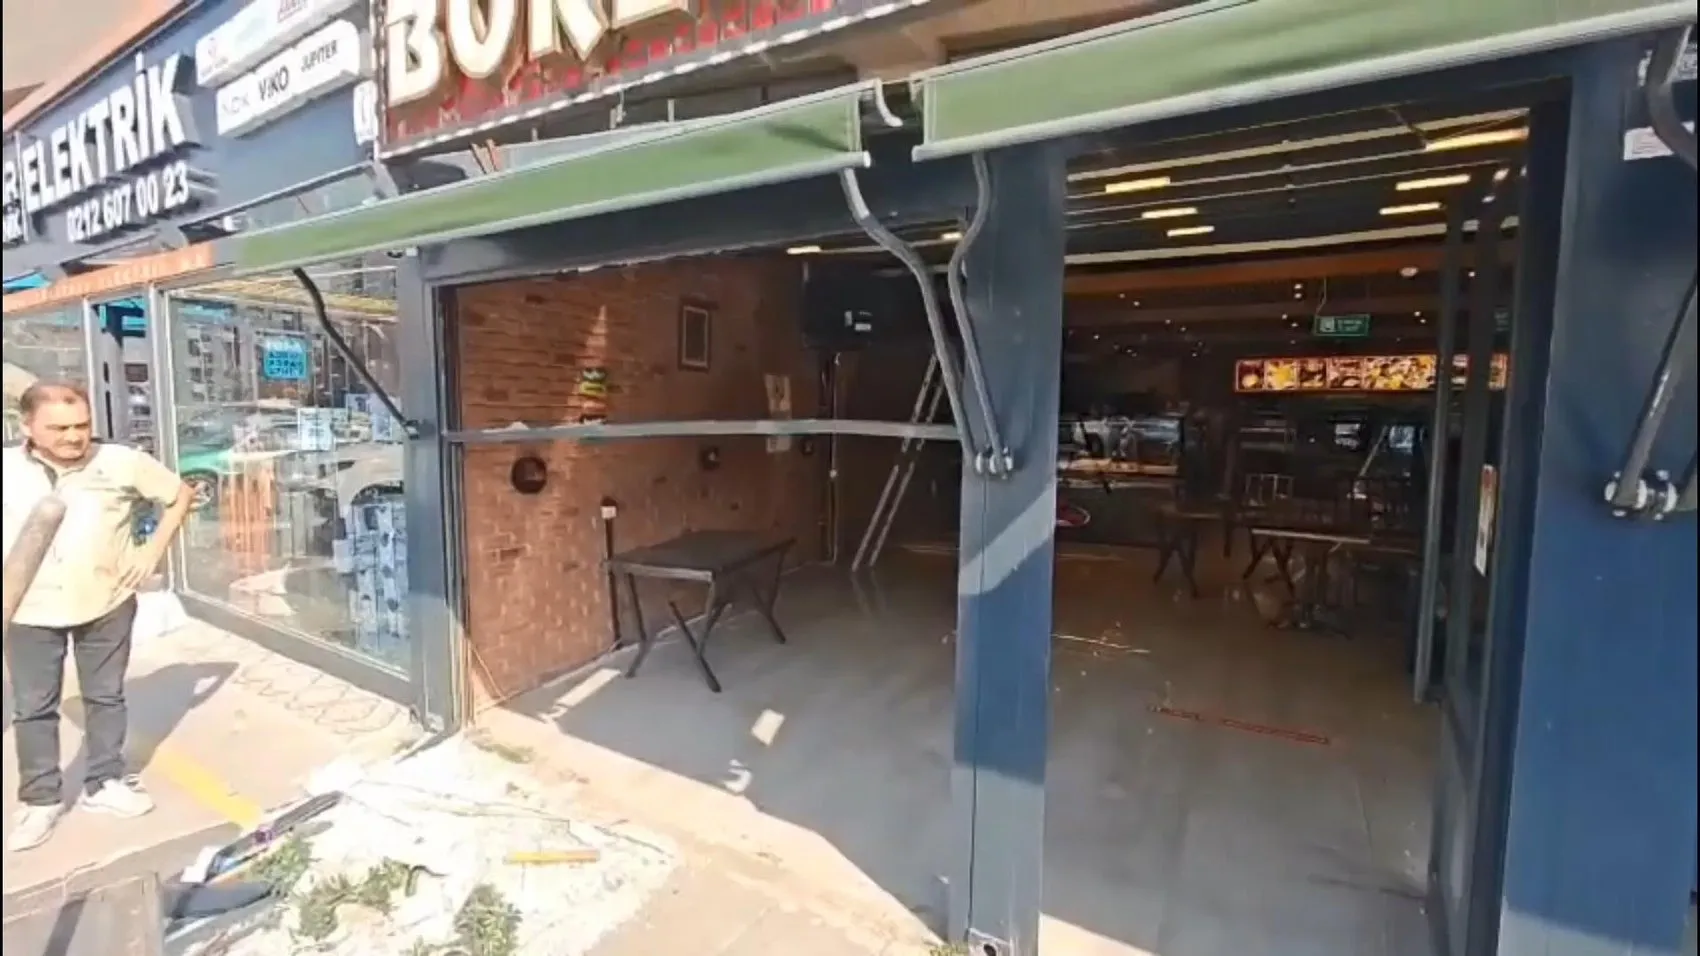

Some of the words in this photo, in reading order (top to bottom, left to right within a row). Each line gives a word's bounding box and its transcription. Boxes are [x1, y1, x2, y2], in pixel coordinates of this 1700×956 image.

[22, 52, 188, 214] ELEKTRİK
[67, 199, 100, 242] 0212
[103, 184, 132, 230] 607
[136, 174, 159, 218] 00
[162, 161, 189, 210] 23
